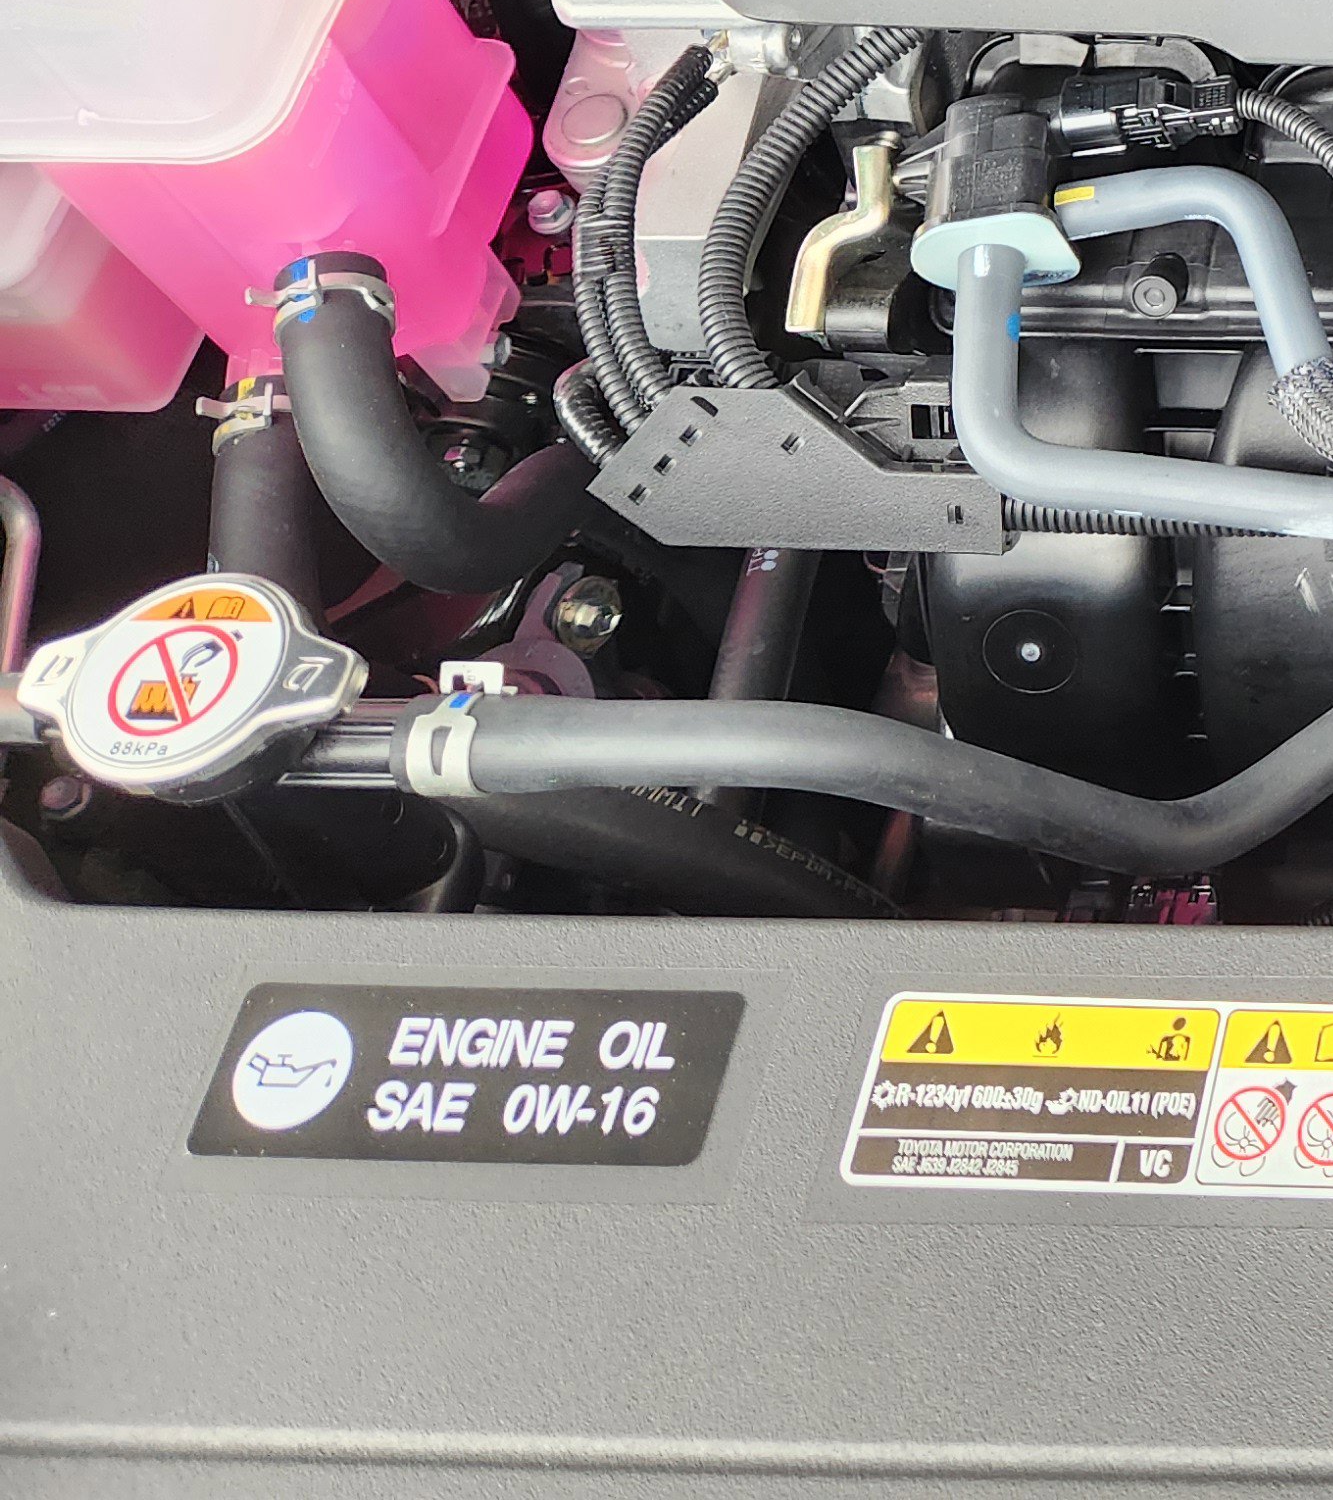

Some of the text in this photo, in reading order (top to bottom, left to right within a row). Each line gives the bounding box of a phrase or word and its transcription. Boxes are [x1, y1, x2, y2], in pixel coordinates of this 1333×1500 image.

[109, 741, 168, 756] 88kPa
[388, 1017, 676, 1071] ENGINE OIL
[366, 1079, 661, 1136] SAE 0W-16
[1150, 1091, 1197, 1121] (POE)
[897, 1138, 1074, 1162] TOYOTA MOTOR CORPORATION
[1138, 1149, 1174, 1178] VC
[891, 1155, 918, 1175] SAE
